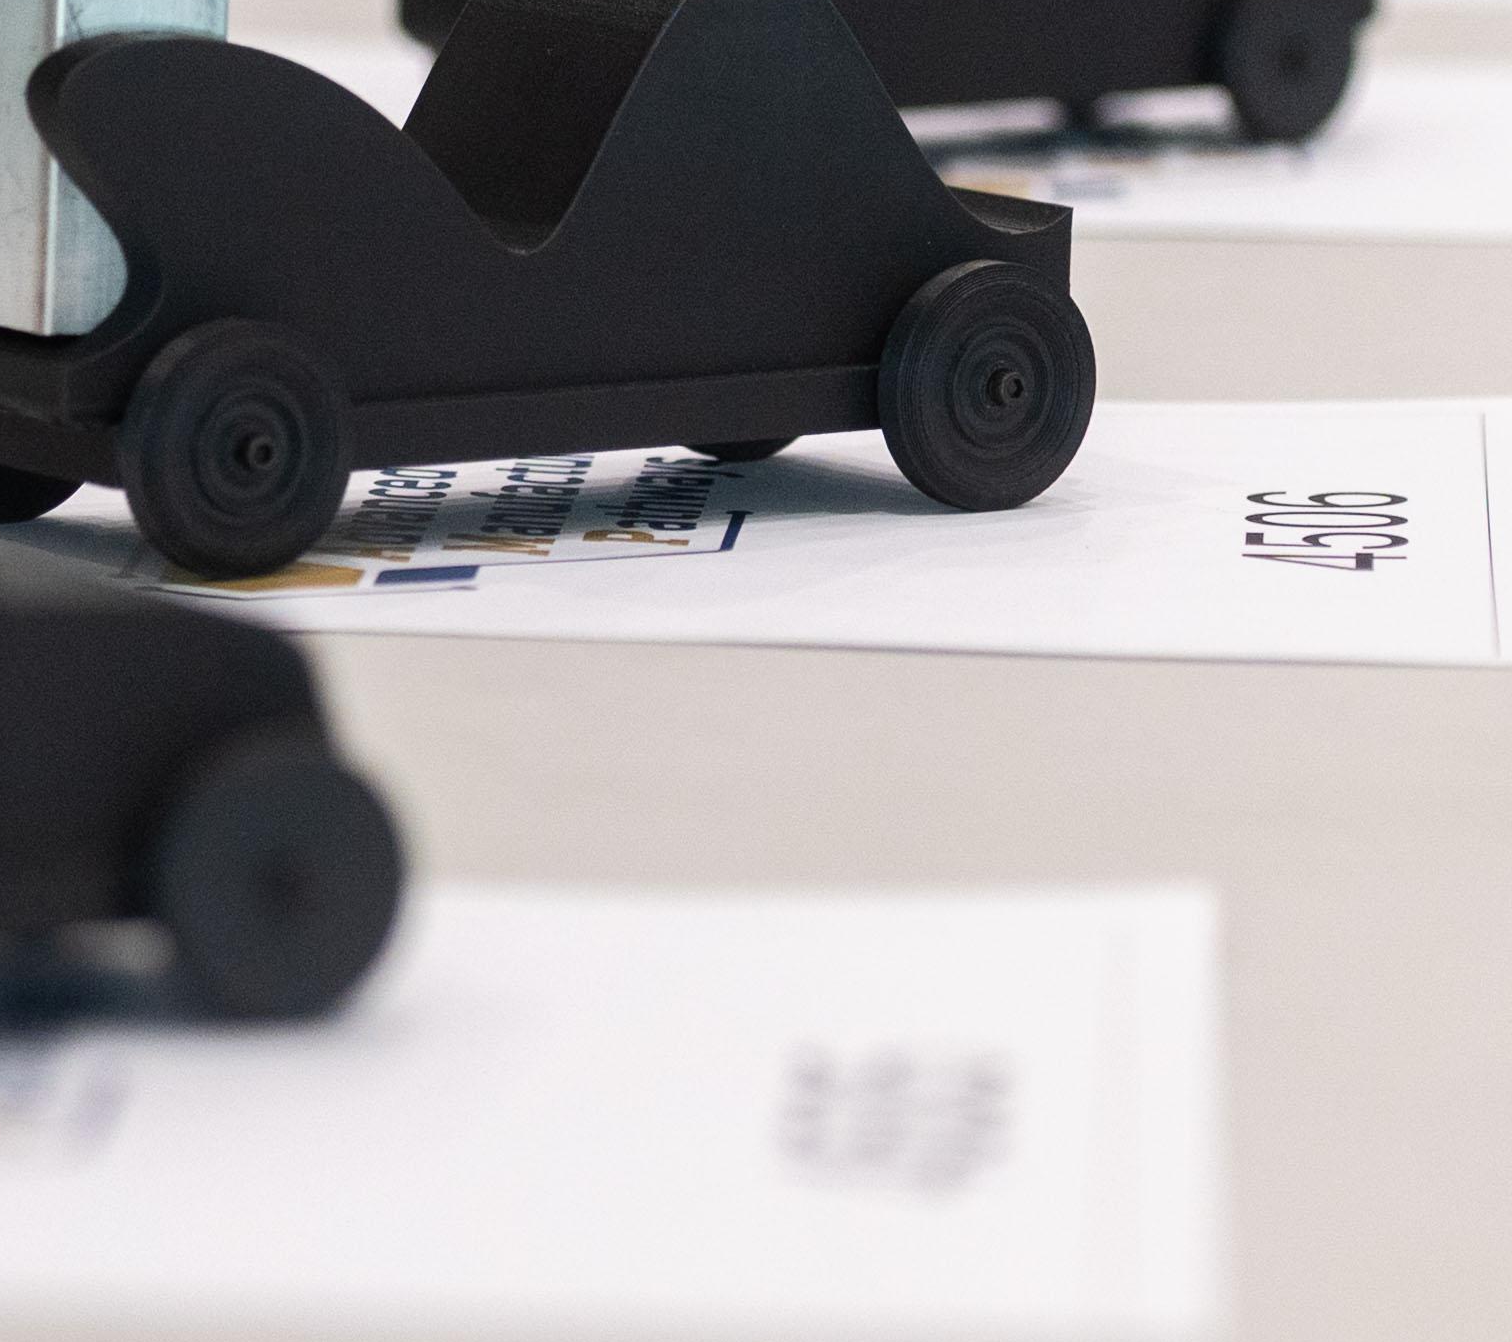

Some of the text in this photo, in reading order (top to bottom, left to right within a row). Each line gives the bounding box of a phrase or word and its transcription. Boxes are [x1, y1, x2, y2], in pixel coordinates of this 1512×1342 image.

[442, 455, 593, 558] Manufactu
[582, 456, 744, 547] Pathways
[1242, 490, 1408, 572] 4506
